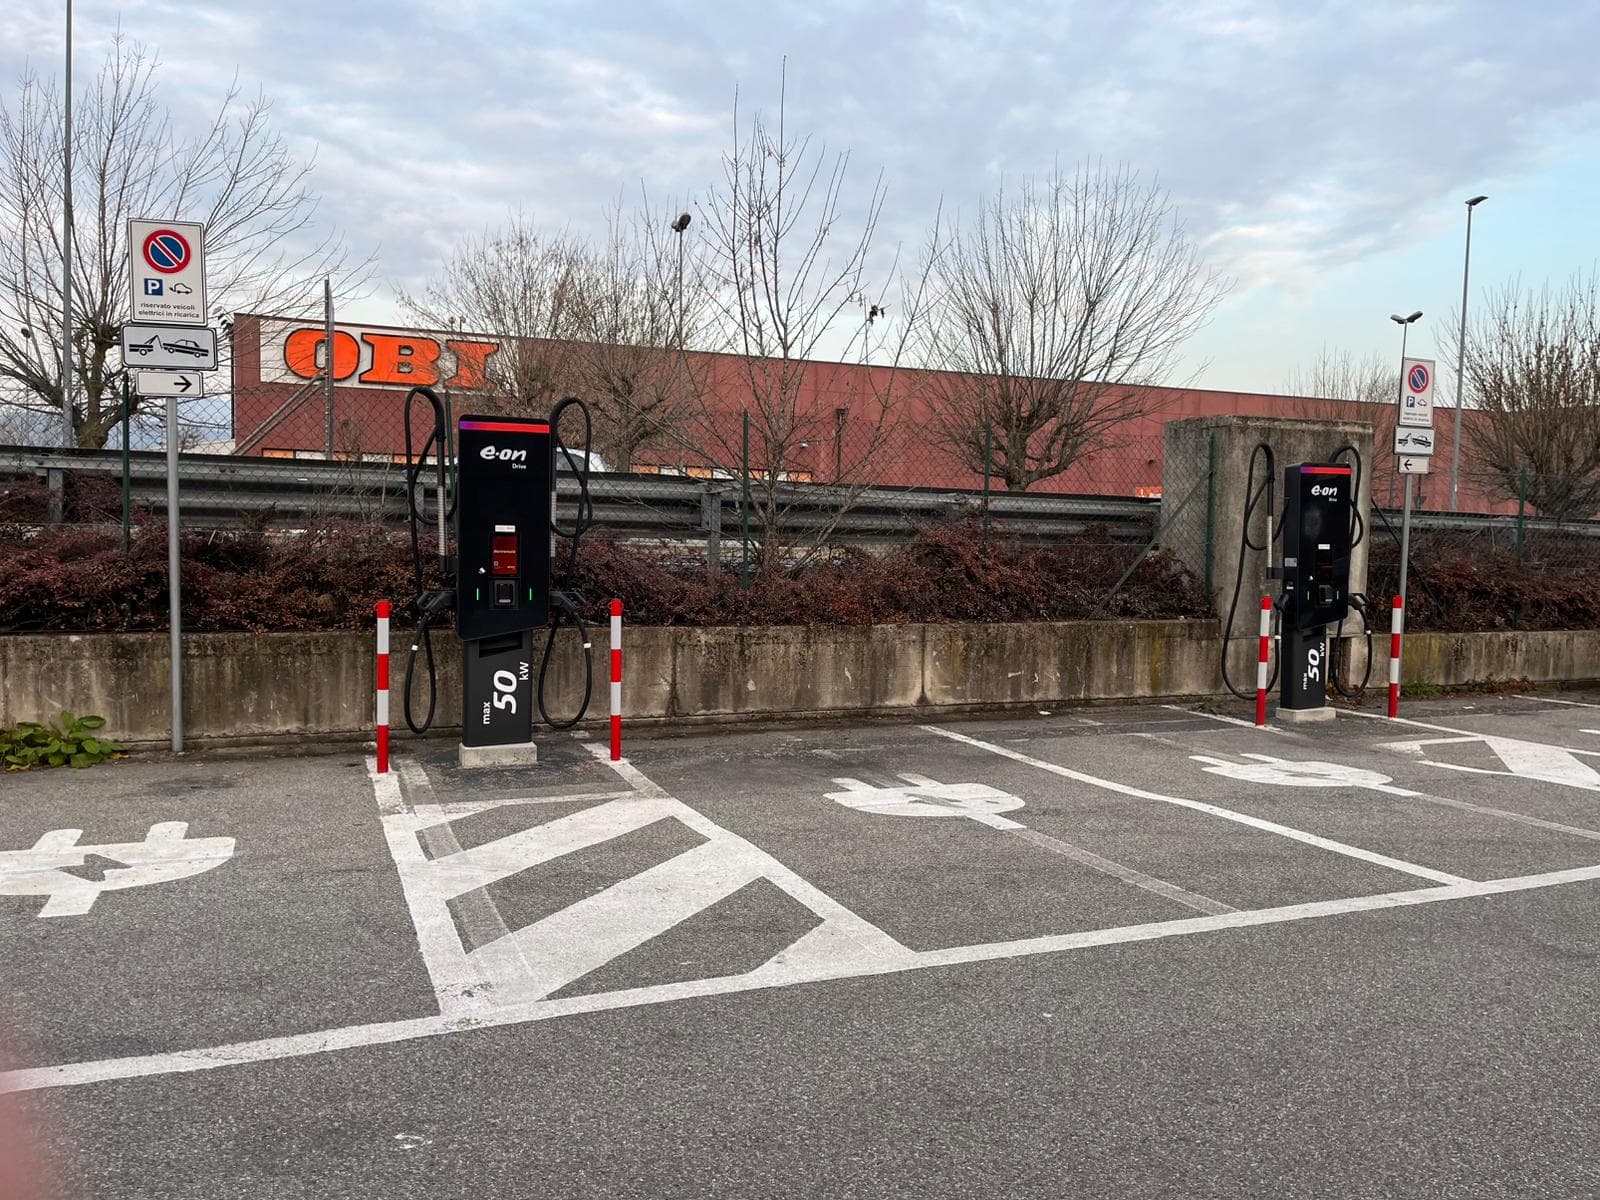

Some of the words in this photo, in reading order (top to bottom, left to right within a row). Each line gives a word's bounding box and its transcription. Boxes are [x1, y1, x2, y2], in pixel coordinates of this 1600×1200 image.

[147, 280, 160, 294] P
[284, 327, 499, 390] OBI
[519, 661, 529, 680] kW
[1307, 648, 1320, 682] 50
[493, 669, 517, 714] 50
[483, 701, 491, 725] max
